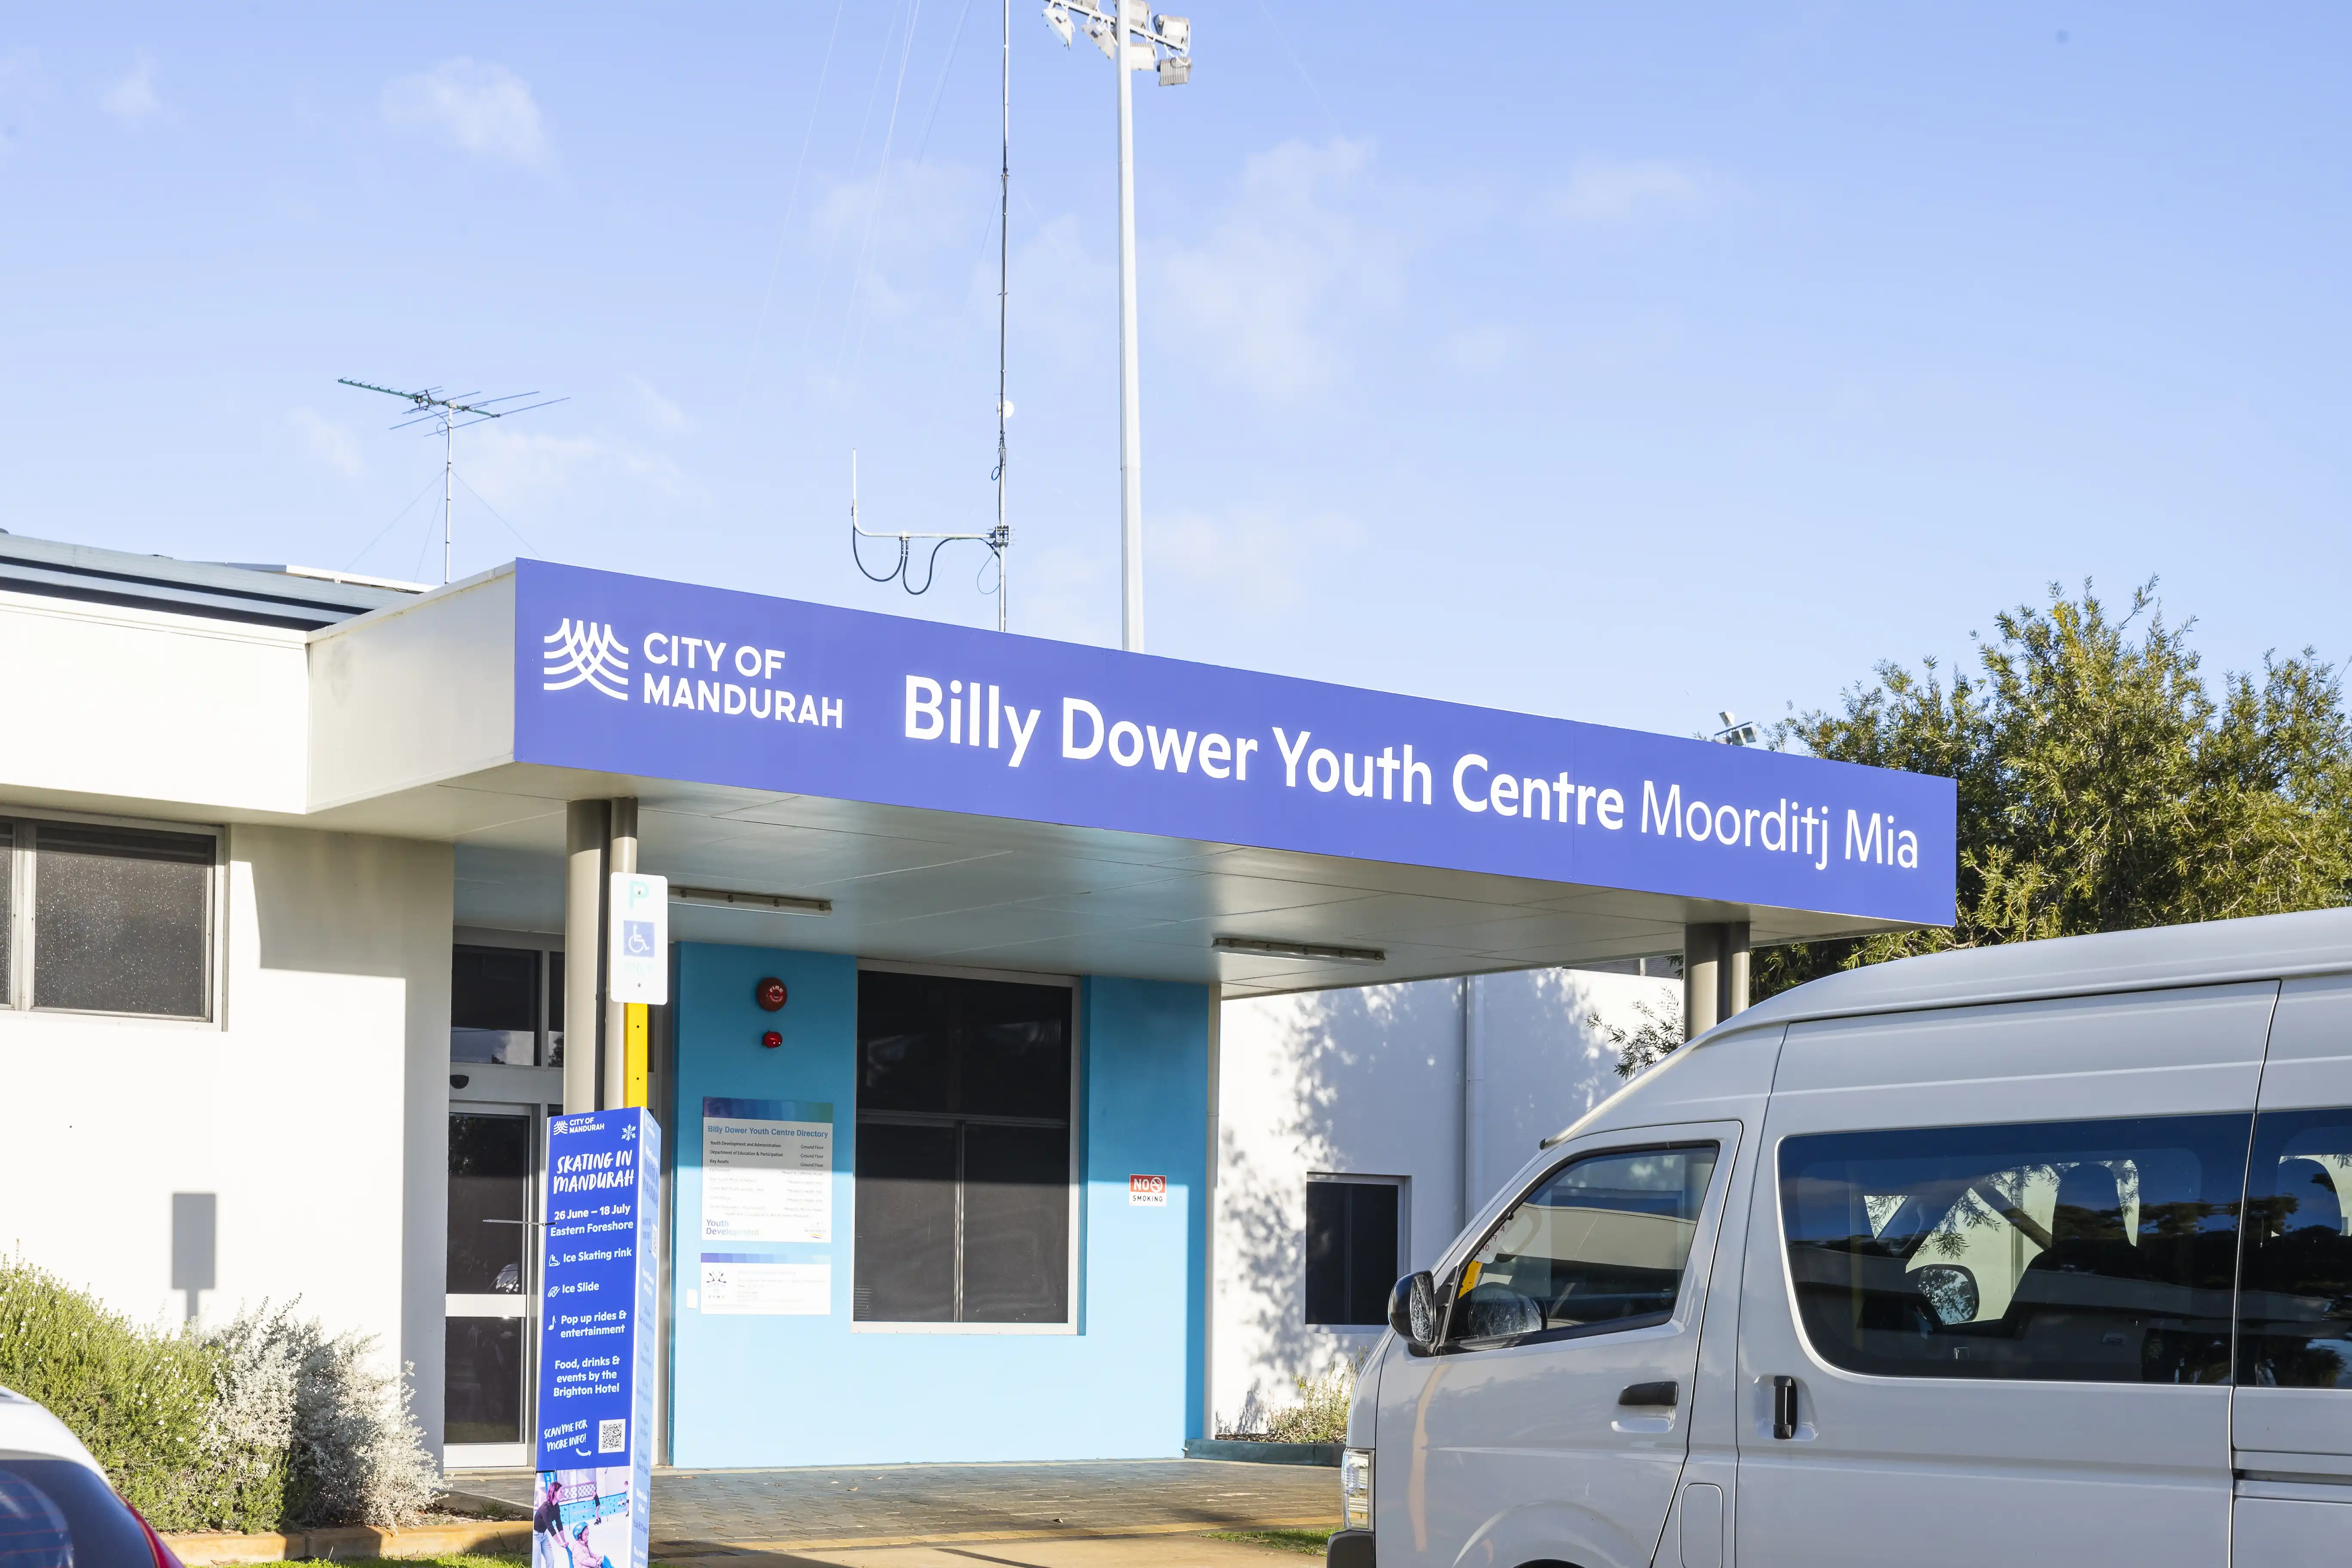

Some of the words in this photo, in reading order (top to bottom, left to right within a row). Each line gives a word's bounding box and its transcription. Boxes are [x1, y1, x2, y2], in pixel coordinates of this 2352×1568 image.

[643, 632, 727, 672] CITY
[735, 646, 785, 680] OF
[644, 672, 842, 729] MANDURAH
[905, 674, 1041, 768] Billy
[1063, 697, 1258, 781] Dower
[1272, 726, 1432, 805] Youth
[1452, 753, 1624, 830] Centre
[1641, 780, 1828, 870] Moorditj
[1845, 809, 1917, 869] Mia
[629, 880, 649, 909] P
[569, 1123, 605, 1133] MANDURAH
[570, 1118, 584, 1126] CITY
[796, 1130, 828, 1138] Directory
[556, 1152, 614, 1174] SKATING
[616, 1149, 633, 1167] IN
[553, 1169, 634, 1194] MANDURAH
[1133, 1179, 1149, 1191] NO
[554, 1210, 566, 1220] 26
[567, 1209, 589, 1219] June
[600, 1206, 610, 1216] 18
[611, 1203, 631, 1215] July
[550, 1226, 585, 1237] Eastern
[587, 1221, 634, 1233] Foreshore
[706, 1228, 760, 1236] Development
[563, 1253, 576, 1262] Ice
[578, 1250, 612, 1261] Skating
[614, 1247, 632, 1258] rink
[562, 1284, 575, 1293] Ice
[577, 1281, 599, 1292] Slide
[561, 1315, 578, 1326] Pop
[580, 1315, 592, 1324] up
[594, 1311, 617, 1322] rides
[619, 1310, 627, 1320] &
[560, 1324, 625, 1338] entertainment
[555, 1358, 580, 1369] Food,
[582, 1357, 610, 1367] drinks
[612, 1355, 620, 1365] &
[557, 1372, 587, 1383] events
[588, 1371, 600, 1382] by
[601, 1370, 617, 1379] the
[553, 1386, 593, 1398] Brighton
[595, 1382, 619, 1394] Hotel
[544, 1426, 561, 1439] SCAN
[561, 1423, 574, 1434] ME
[575, 1419, 588, 1430] FOR
[547, 1439, 568, 1452] MORE
[569, 1433, 586, 1446] INFO!
